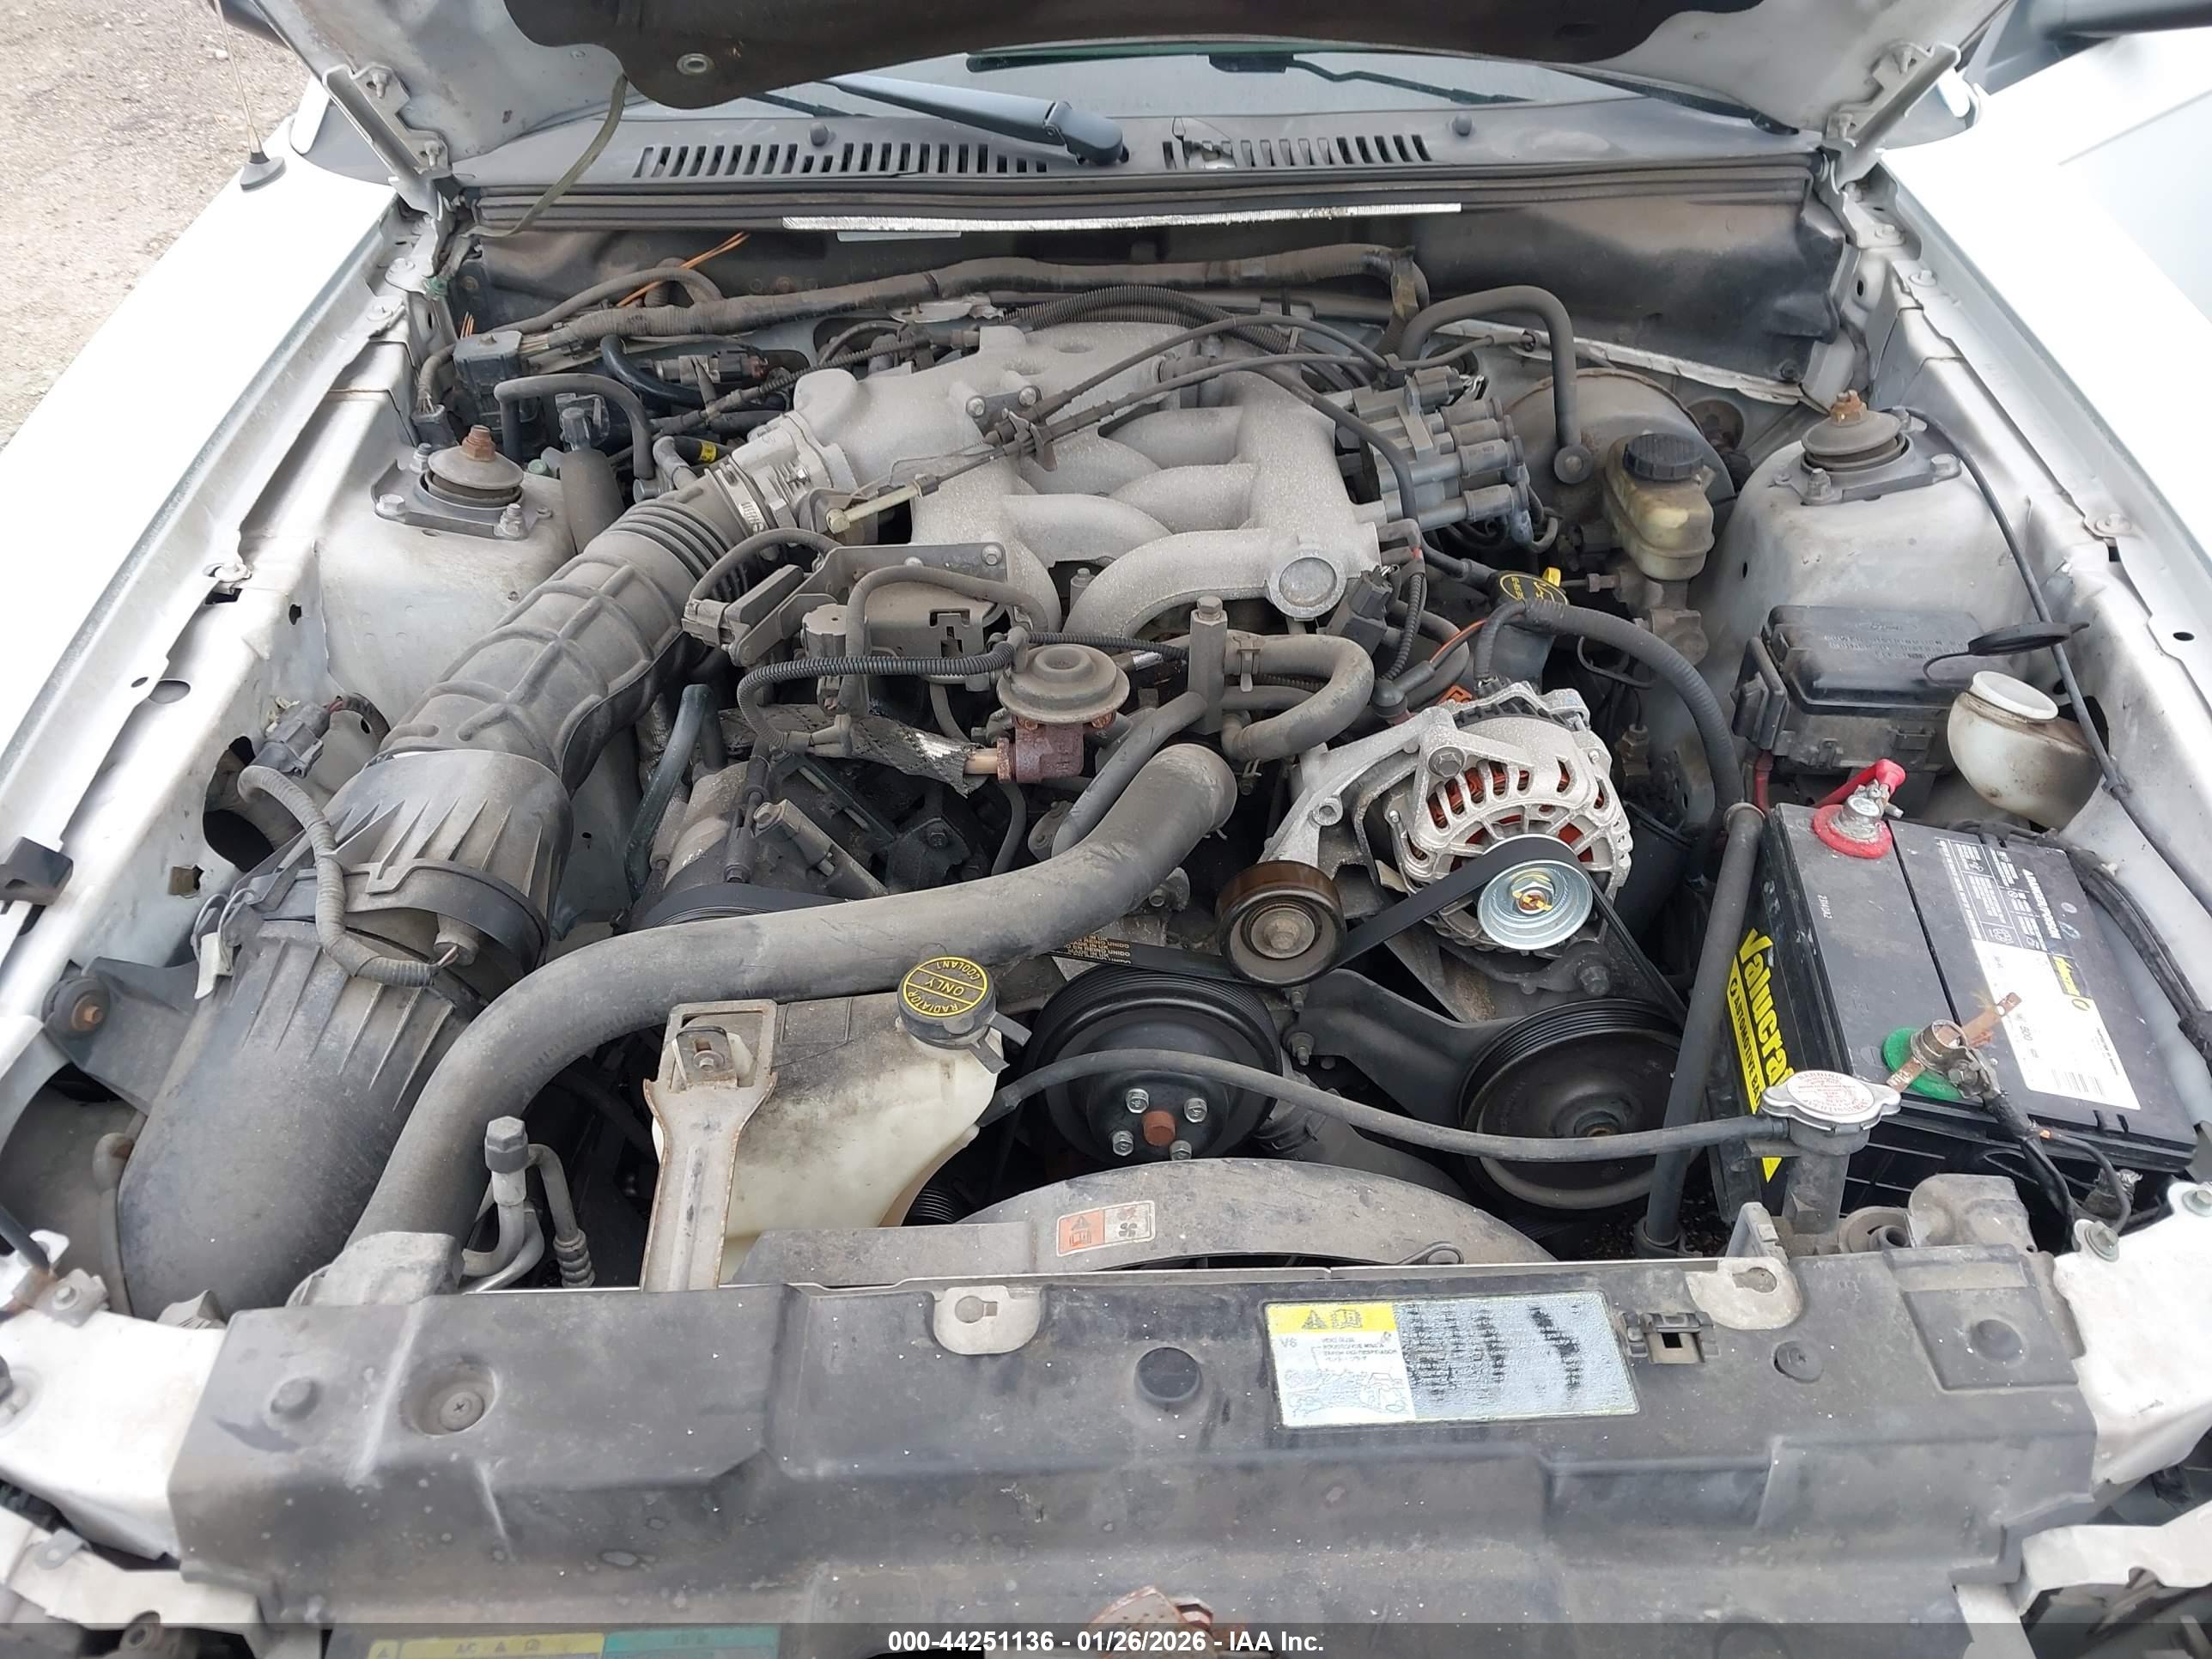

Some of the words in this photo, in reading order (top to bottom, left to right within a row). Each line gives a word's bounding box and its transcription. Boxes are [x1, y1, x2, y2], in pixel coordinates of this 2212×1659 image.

[924, 977, 965, 997] ONLY
[909, 989, 960, 1015] RADIATOR
[1734, 992, 1756, 1078] AUTOMOTIVE
